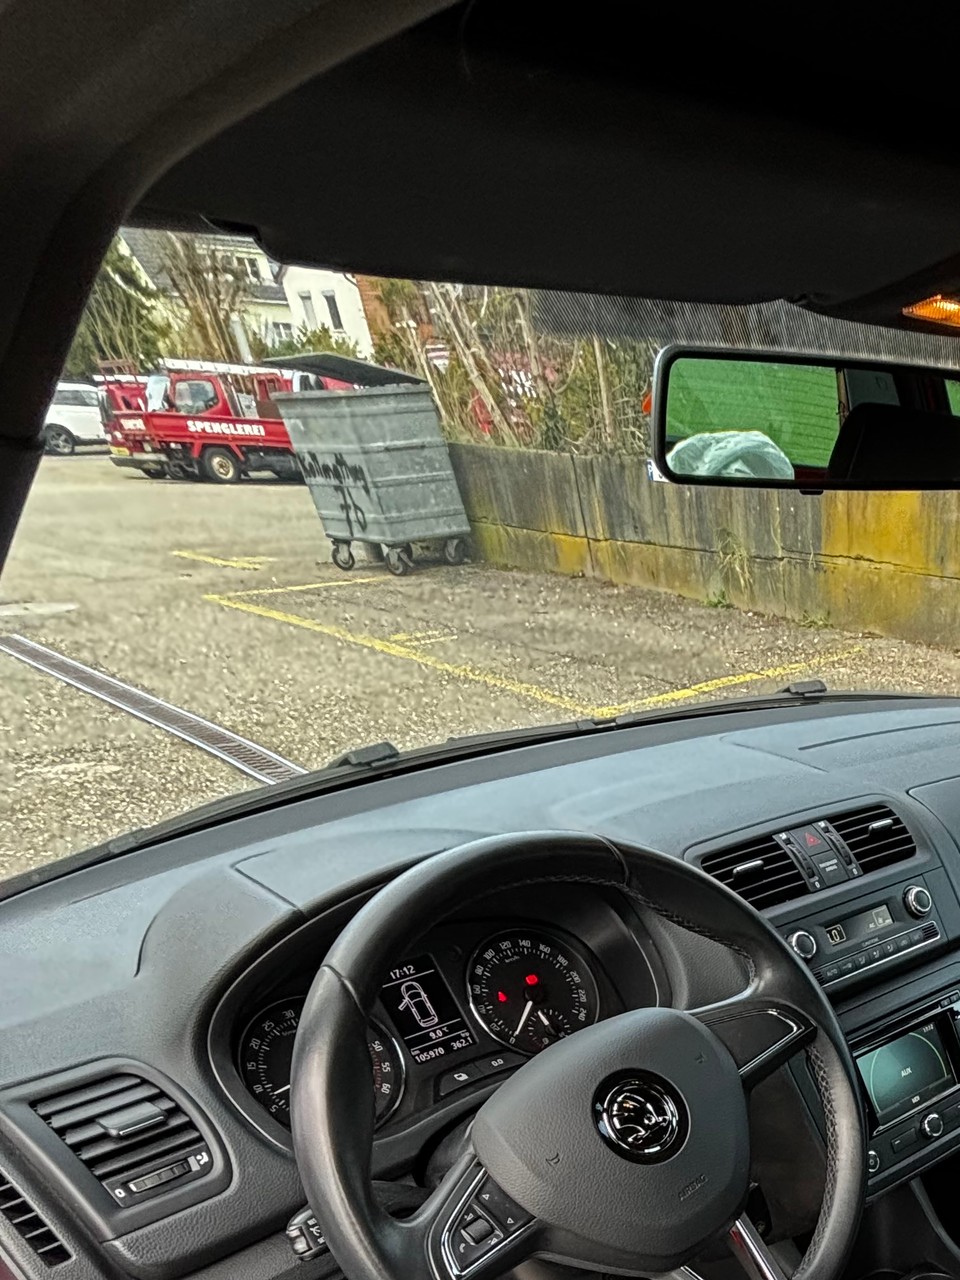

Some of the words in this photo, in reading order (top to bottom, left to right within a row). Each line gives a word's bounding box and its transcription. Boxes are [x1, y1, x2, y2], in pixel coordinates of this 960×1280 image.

[186, 420, 265, 436] SPENGLEREI
[499, 940, 512, 950] 120
[518, 939, 531, 947] 140
[539, 943, 551, 954] 160
[483, 949, 495, 960] 100
[556, 954, 568, 966] 180
[390, 965, 416, 980] 17:12
[475, 965, 484, 975] 80
[570, 970, 581, 983] 200
[473, 984, 481, 994] 60
[578, 989, 587, 1002] 220
[282, 1009, 295, 1019] 30
[578, 1007, 587, 1021] 240
[262, 1020, 274, 1031] 25
[249, 1038, 261, 1050] 20
[372, 1040, 383, 1052] 50
[415, 1047, 445, 1063] 105970
[451, 1036, 473, 1050] 362.1
[247, 1061, 256, 1070] 15
[381, 1062, 391, 1073] 55
[901, 1066, 913, 1078] AUX
[253, 1084, 264, 1094] 10
[381, 1083, 391, 1094] 60
[270, 1104, 279, 1113] 5
